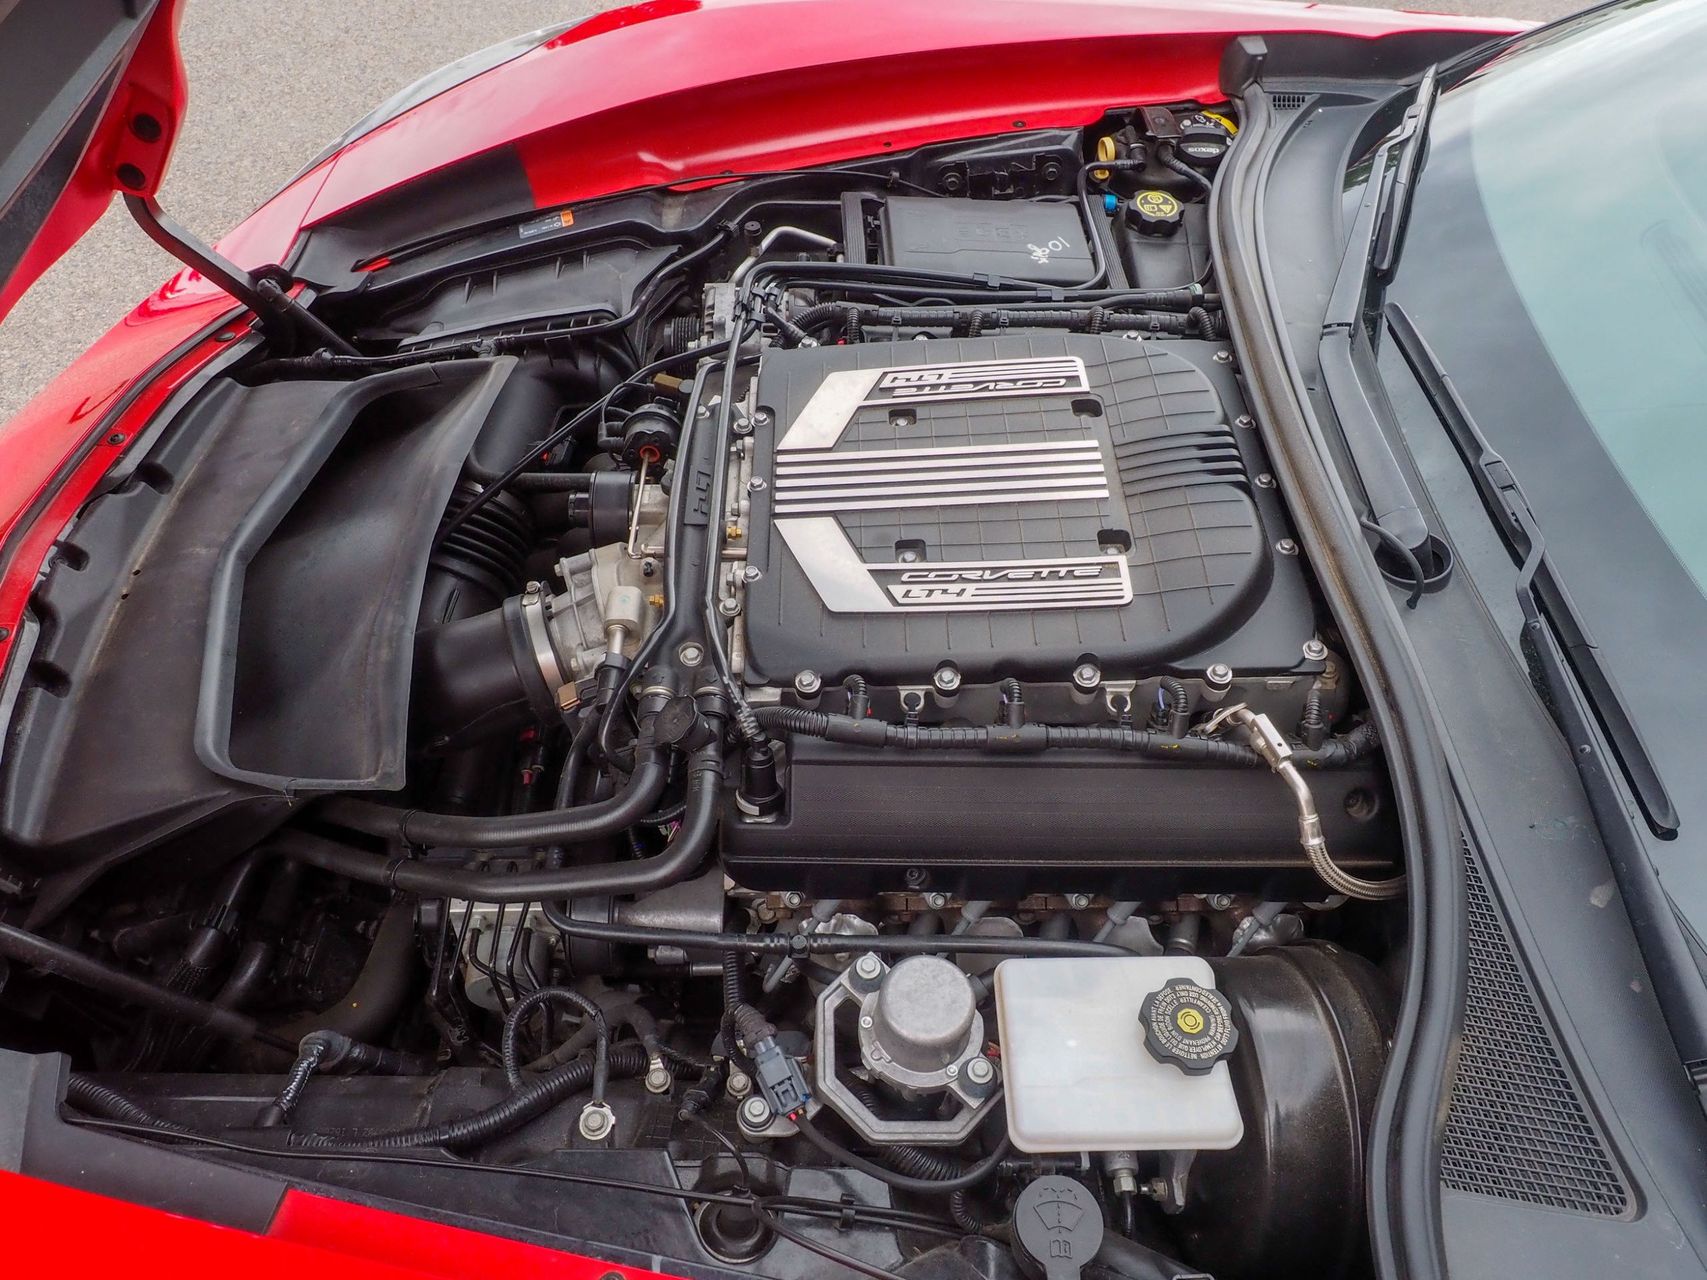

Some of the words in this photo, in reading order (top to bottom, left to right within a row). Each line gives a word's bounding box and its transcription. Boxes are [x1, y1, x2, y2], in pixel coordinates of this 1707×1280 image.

[890, 373, 944, 383] LT4
[893, 378, 1066, 396] CORVETTE
[901, 565, 1102, 582] CORVETTE
[902, 587, 967, 599] LT4
[1163, 1040, 1173, 1050] LE
